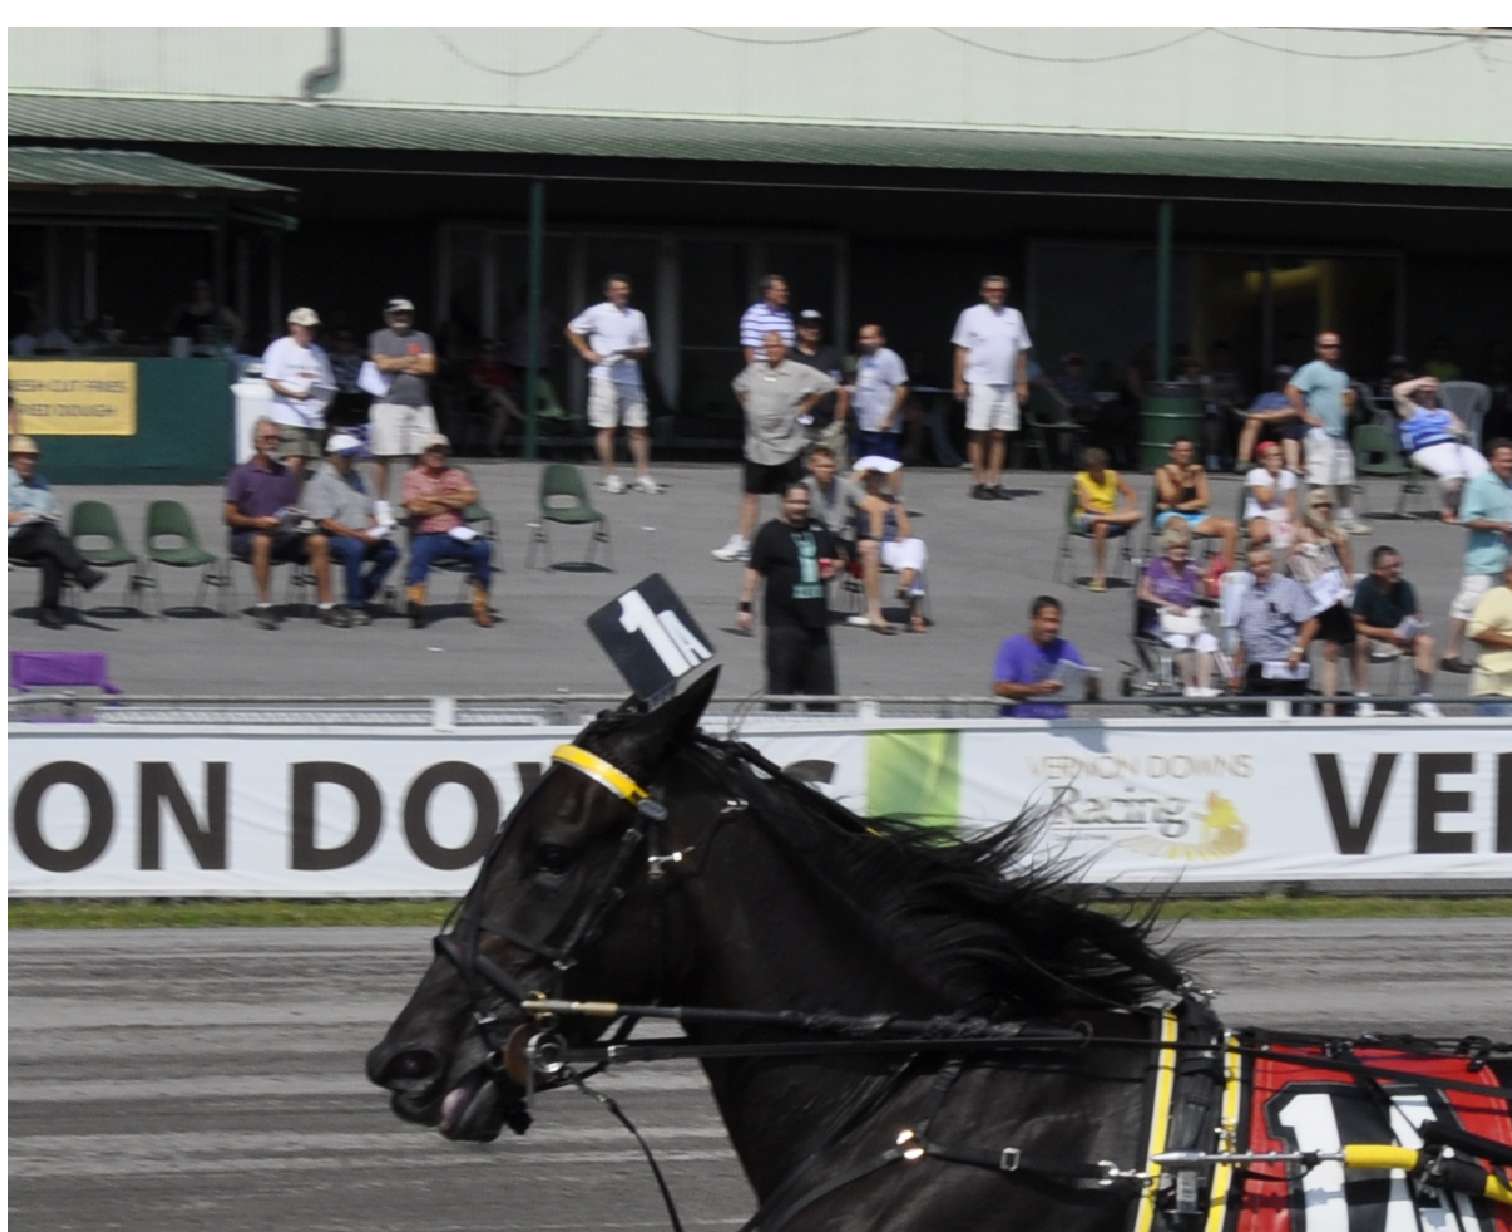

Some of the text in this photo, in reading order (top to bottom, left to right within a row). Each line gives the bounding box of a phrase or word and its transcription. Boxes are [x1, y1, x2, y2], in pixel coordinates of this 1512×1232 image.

[617, 589, 713, 678] 1A
[1149, 755, 1256, 778] DOWNS
[1048, 785, 1192, 839] Racing
